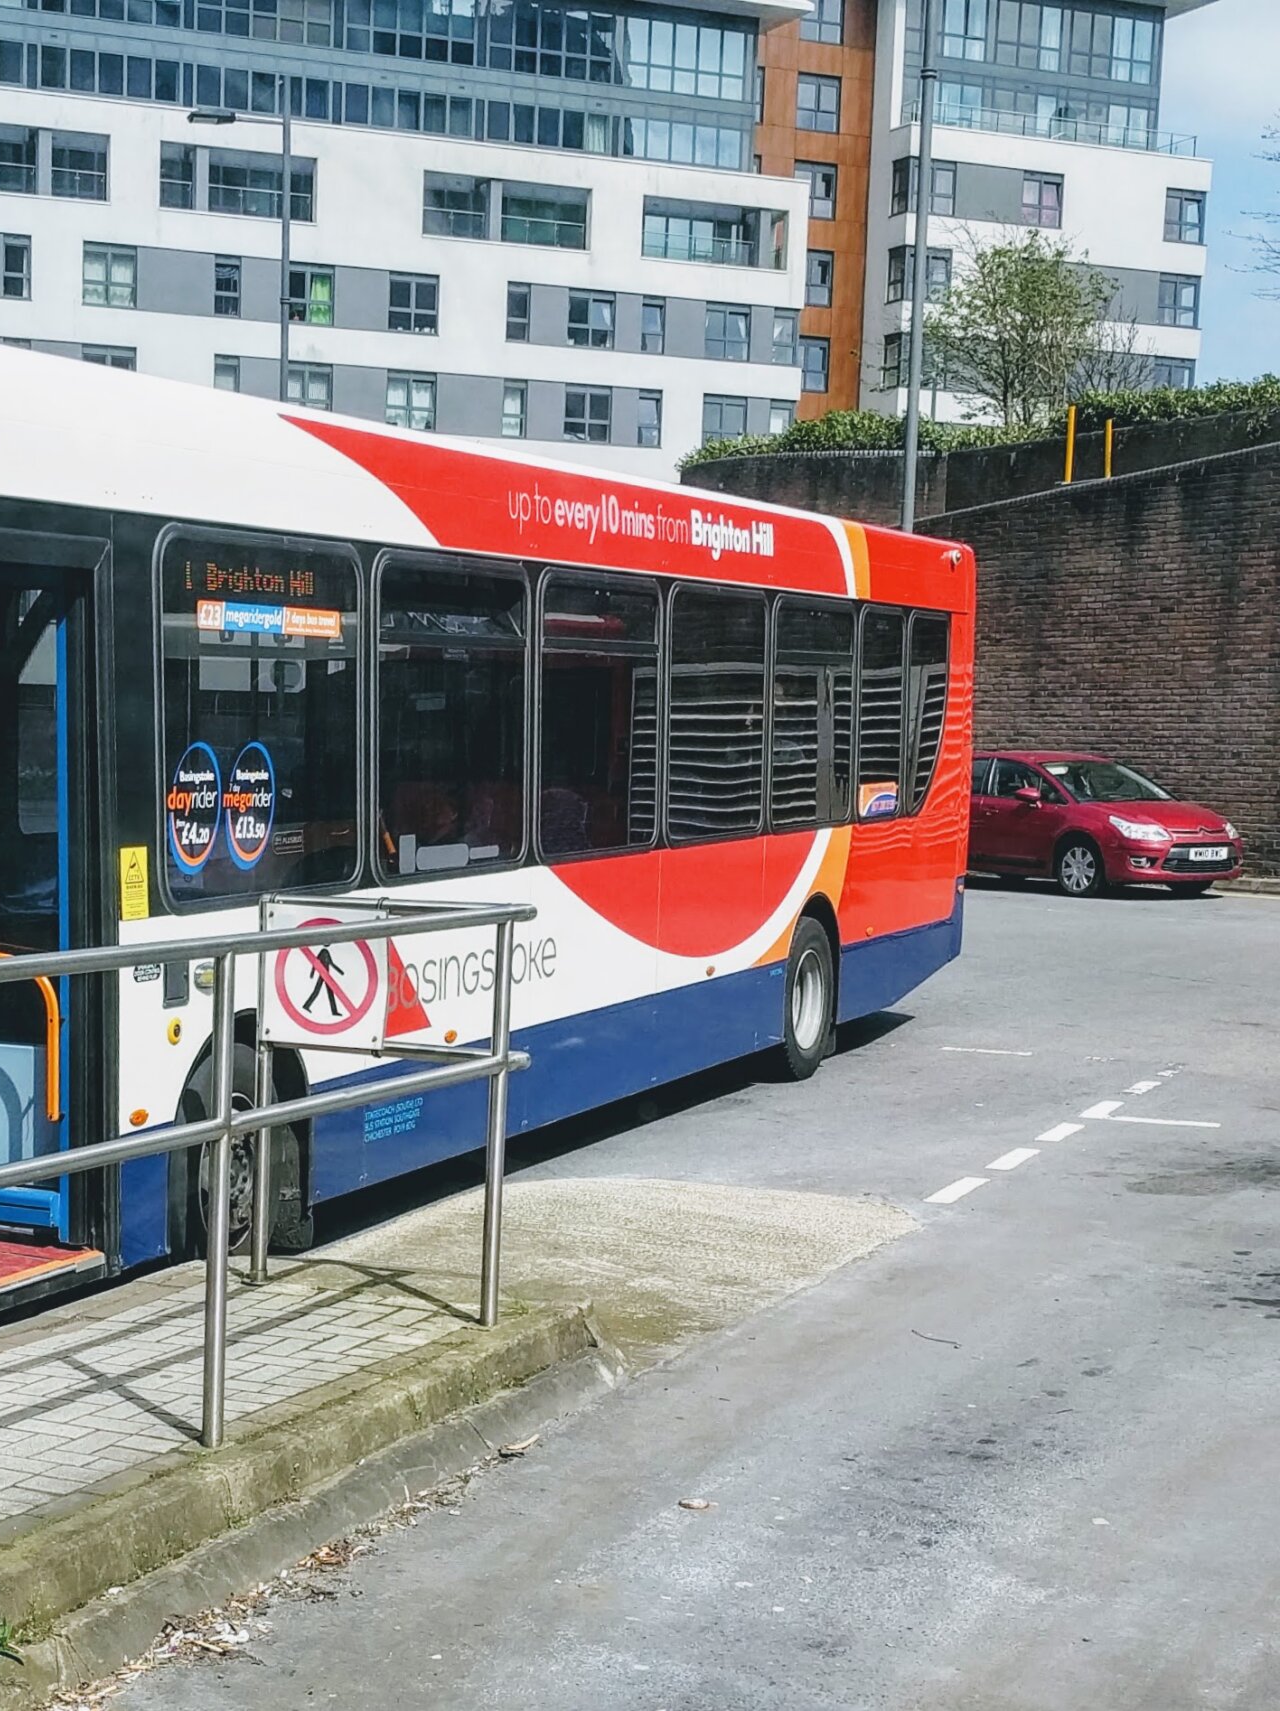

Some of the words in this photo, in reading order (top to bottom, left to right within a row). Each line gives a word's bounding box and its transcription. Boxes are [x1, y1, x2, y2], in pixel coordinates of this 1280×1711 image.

[508, 489, 532, 535] up
[533, 482, 552, 524] to
[554, 500, 601, 545] every
[601, 494, 619, 535] 10
[621, 501, 656, 541] mins
[657, 504, 689, 543] from
[690, 509, 750, 561] Brighton
[752, 520, 775, 557] Hill
[206, 562, 285, 593] Brighton
[199, 603, 221, 627] £23
[225, 608, 283, 631] megaridergold
[168, 784, 218, 817] dayrider
[223, 787, 272, 813] megarider
[181, 821, 210, 845] £4.20
[235, 816, 266, 839] £13.50
[388, 937, 557, 1014] Basingsoke
